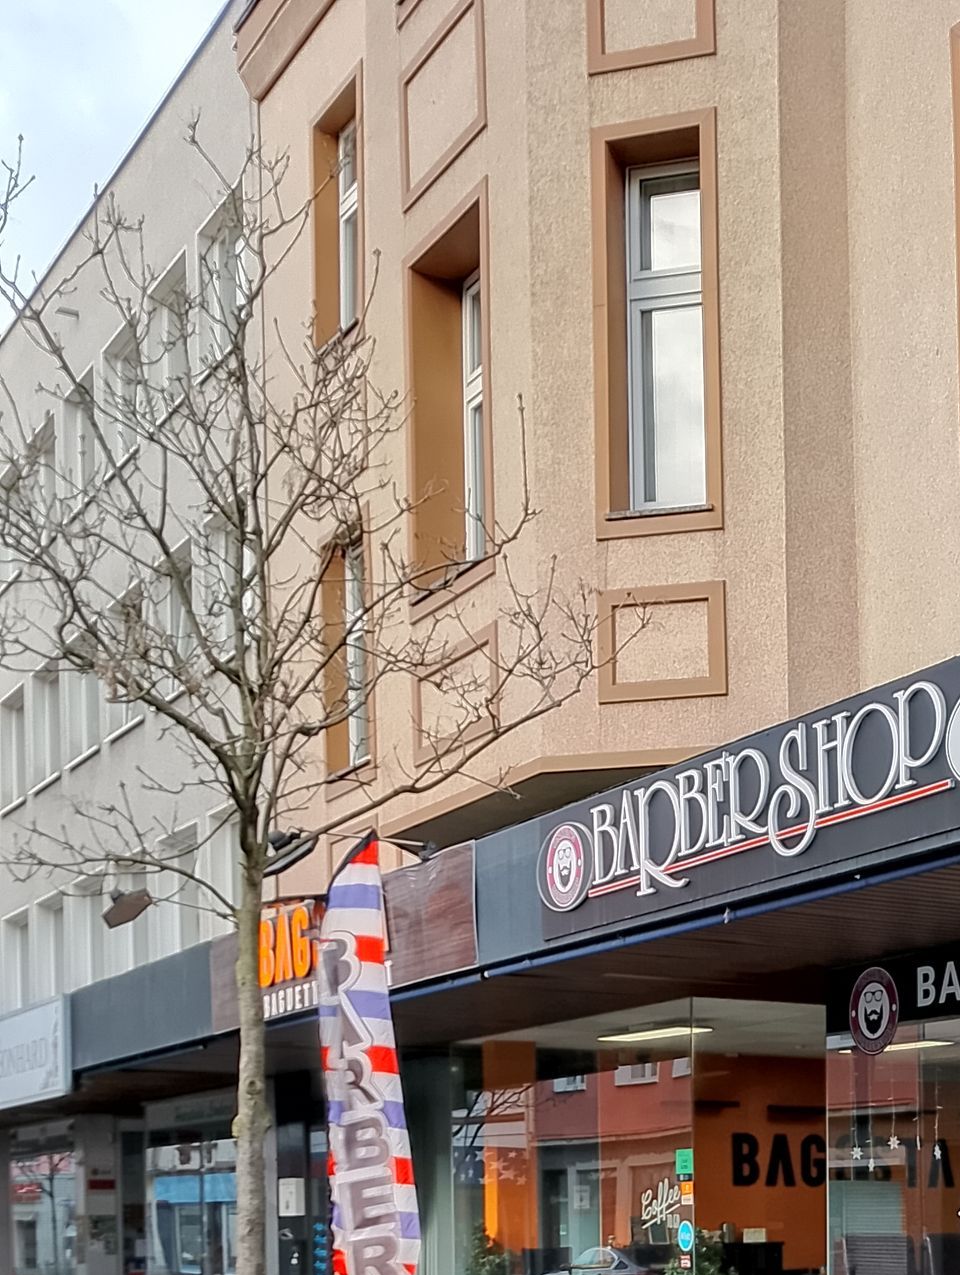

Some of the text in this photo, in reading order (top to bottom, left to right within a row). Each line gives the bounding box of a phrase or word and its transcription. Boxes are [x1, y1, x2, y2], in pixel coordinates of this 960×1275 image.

[259, 905, 318, 988] BAG
[262, 981, 319, 1019] BAGUETT
[641, 1177, 682, 1225] Coffee
